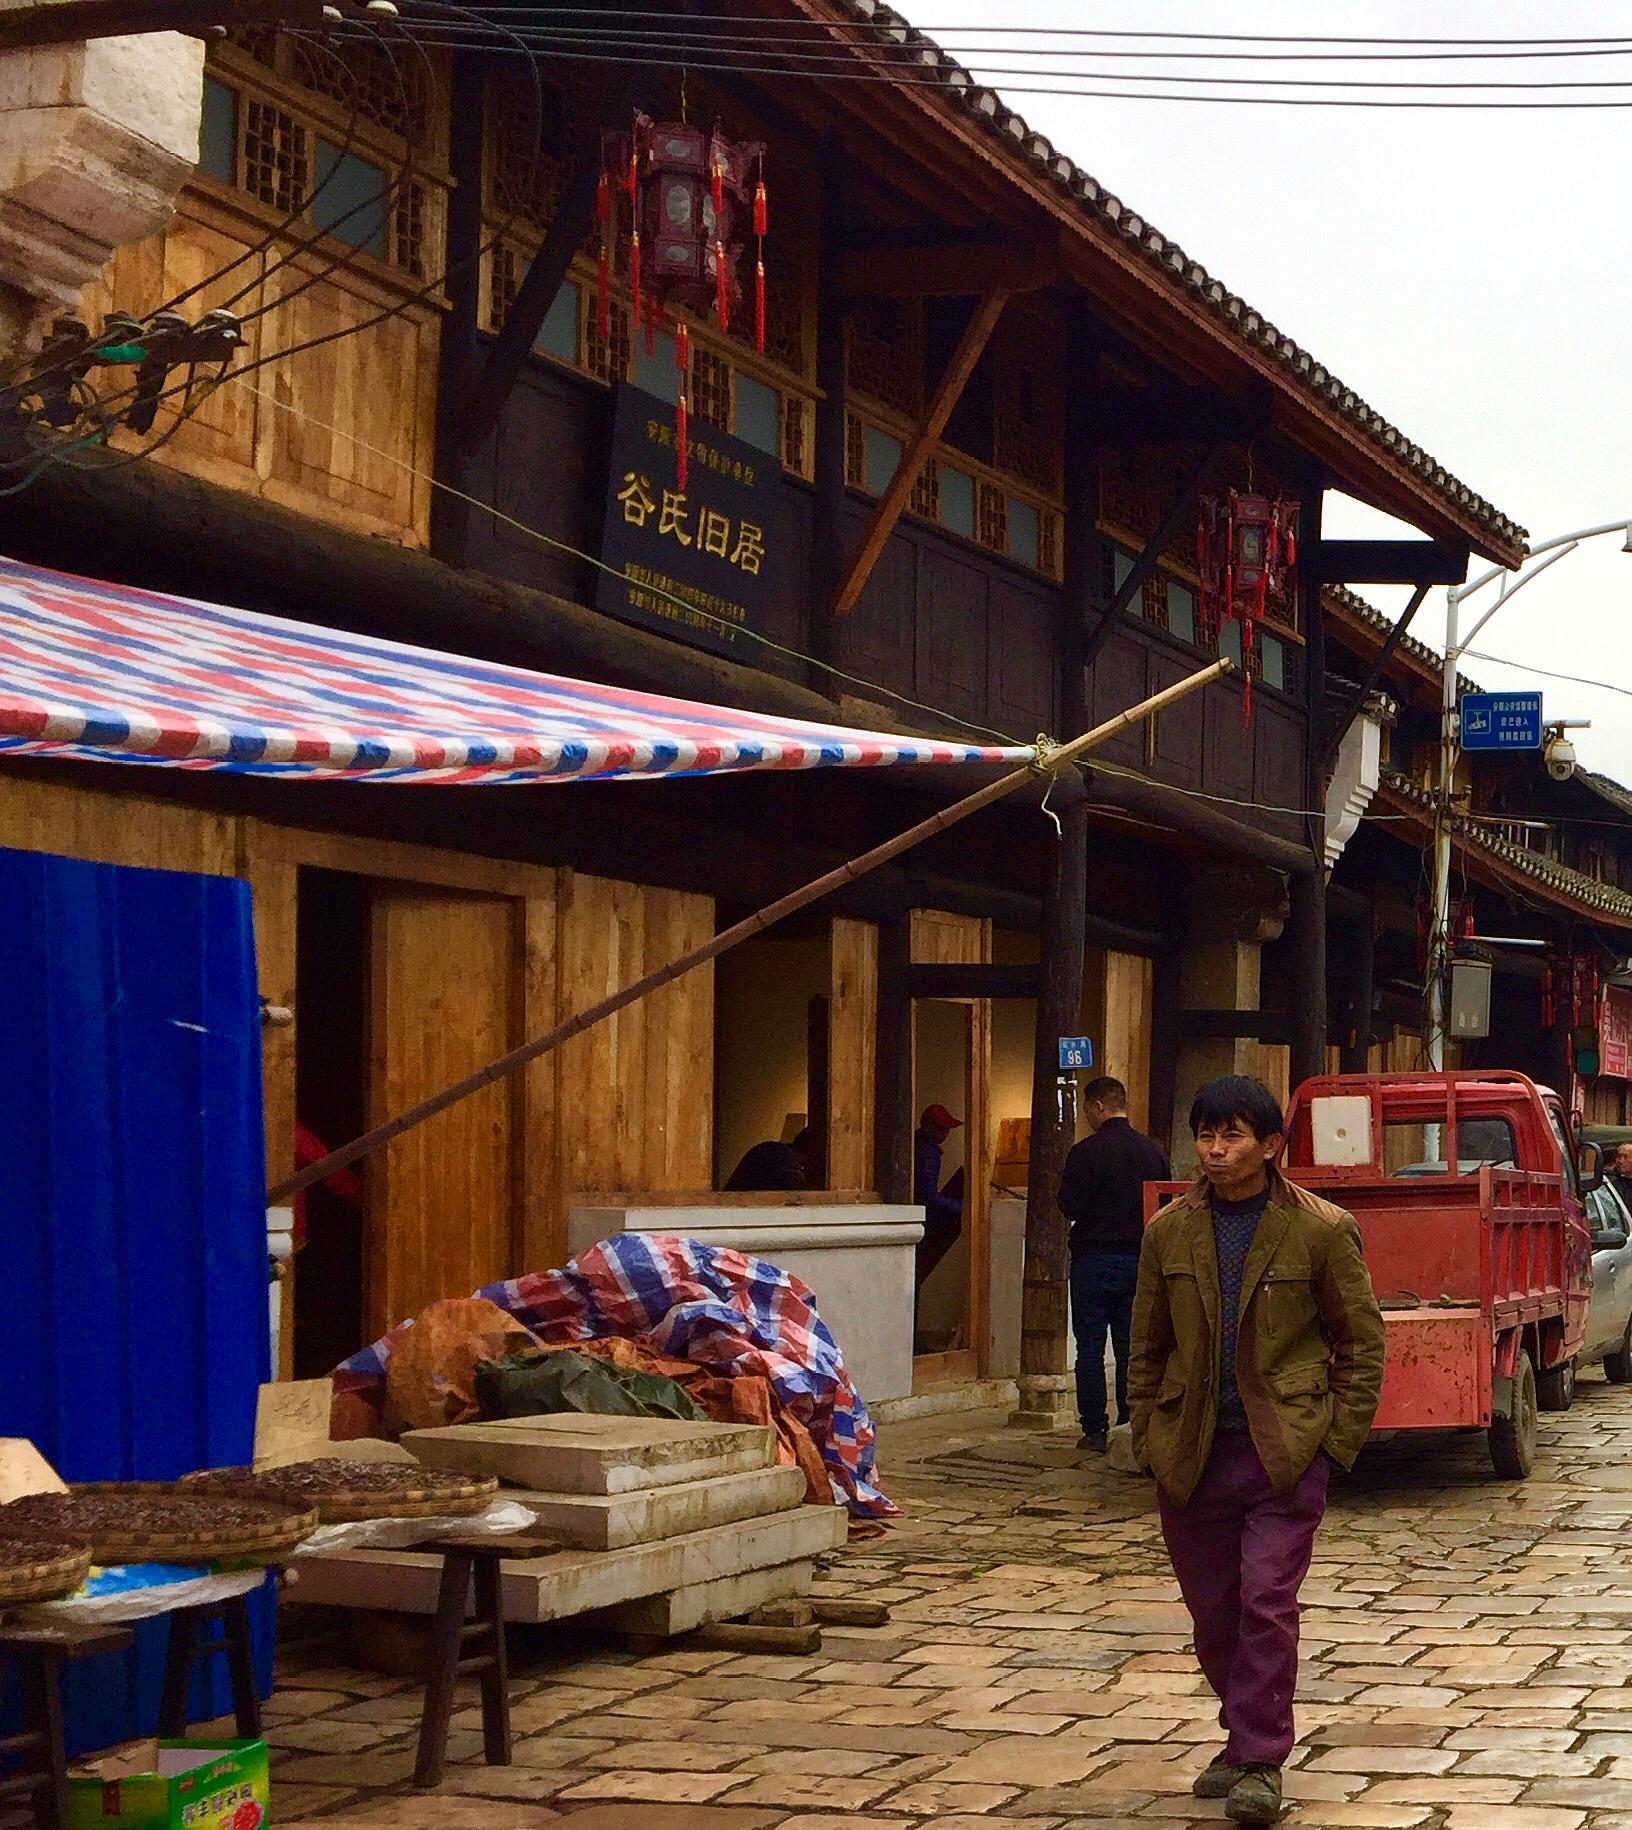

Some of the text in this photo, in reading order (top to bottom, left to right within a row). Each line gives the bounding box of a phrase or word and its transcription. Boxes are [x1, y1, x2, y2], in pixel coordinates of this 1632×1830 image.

[617, 472, 765, 575] 谷氏旧居
[1067, 1050, 1082, 1065] 96
